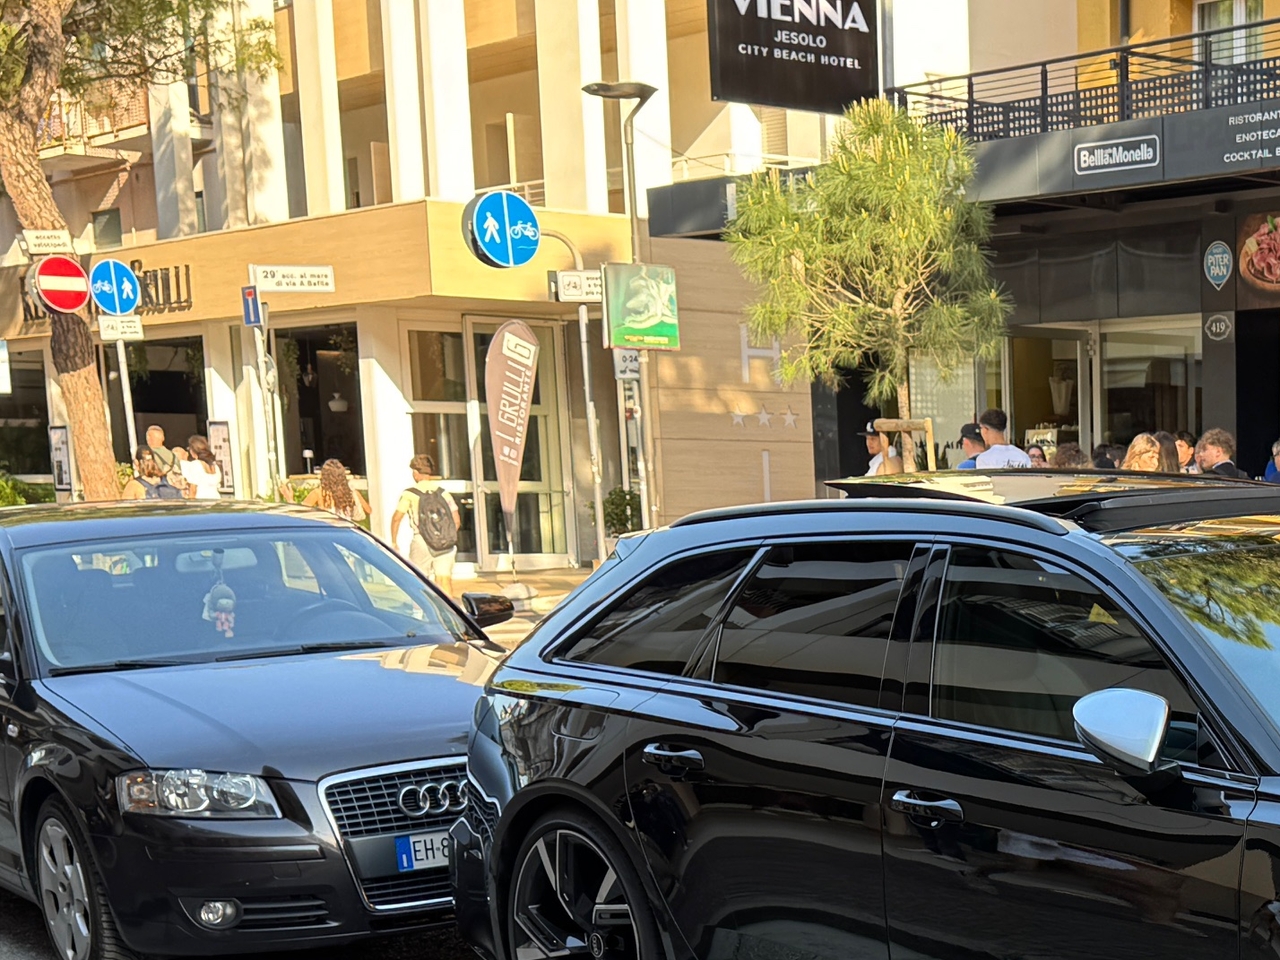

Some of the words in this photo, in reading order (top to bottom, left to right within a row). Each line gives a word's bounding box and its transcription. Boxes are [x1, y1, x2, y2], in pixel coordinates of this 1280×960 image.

[774, 30, 827, 48] JESOLO
[738, 43, 769, 57] CITY
[774, 48, 816, 63] BEACH
[821, 55, 862, 70] HOTEL
[1224, 148, 1273, 163] COCKTAIL
[1208, 253, 1229, 266] PITER
[1210, 265, 1227, 276] PAN
[1211, 322, 1226, 333] 419
[498, 360, 526, 428] GRULLI
[515, 370, 533, 445] RISTORANTE
